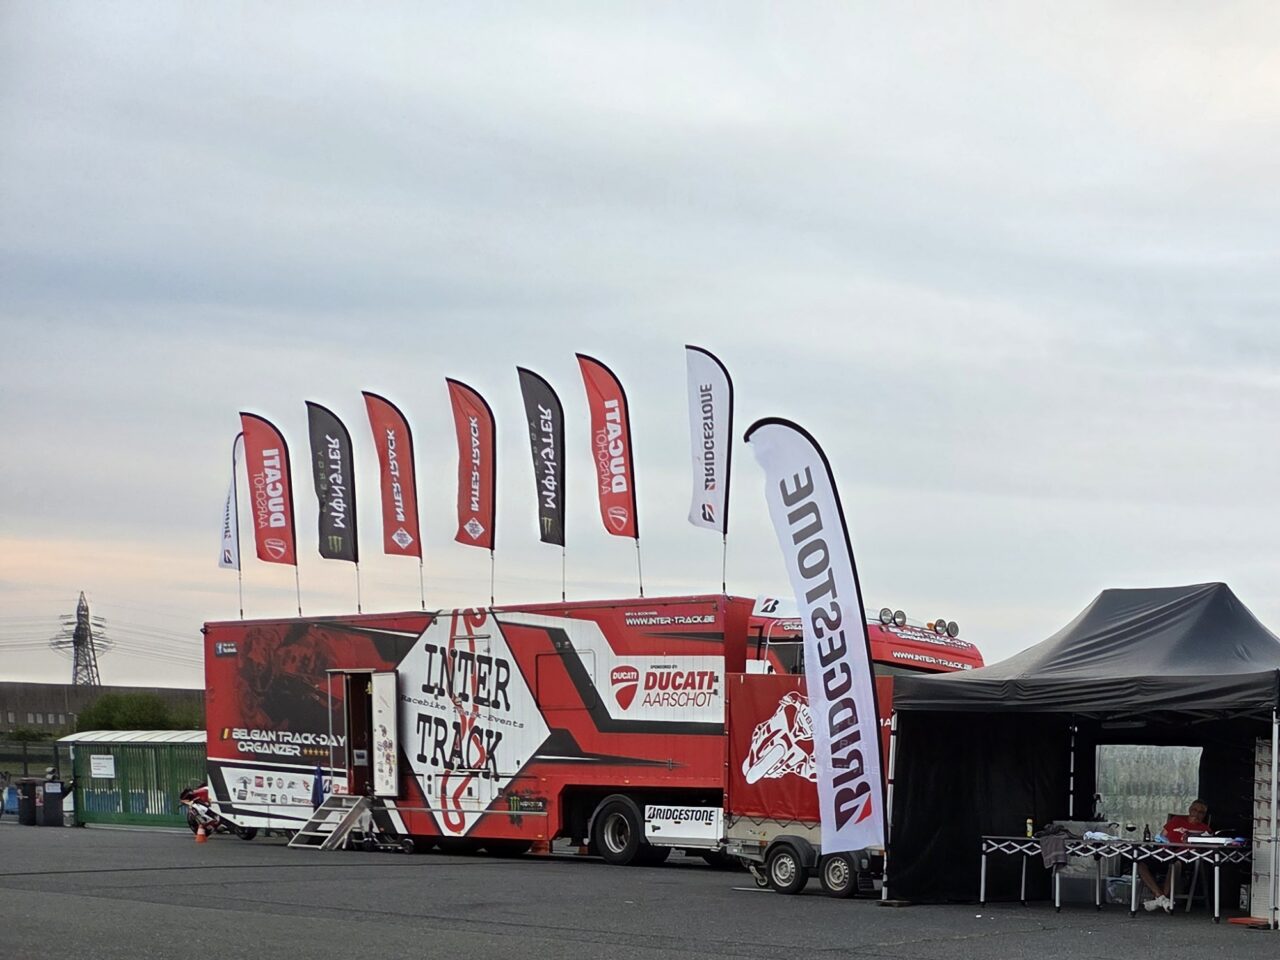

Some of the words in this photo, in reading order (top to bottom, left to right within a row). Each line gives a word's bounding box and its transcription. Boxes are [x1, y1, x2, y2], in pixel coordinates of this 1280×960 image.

[421, 643, 511, 712] INTER
[612, 671, 637, 680] DUCATI
[644, 671, 715, 690] DUCATI
[642, 691, 714, 707] AARSCHOT
[232, 728, 277, 741] BELGIAN
[277, 730, 346, 747] TRACK-DAY
[237, 741, 301, 756] ORGANIZER
[416, 712, 503, 782] TRACK
[647, 807, 715, 821] BRIDGESTONE
